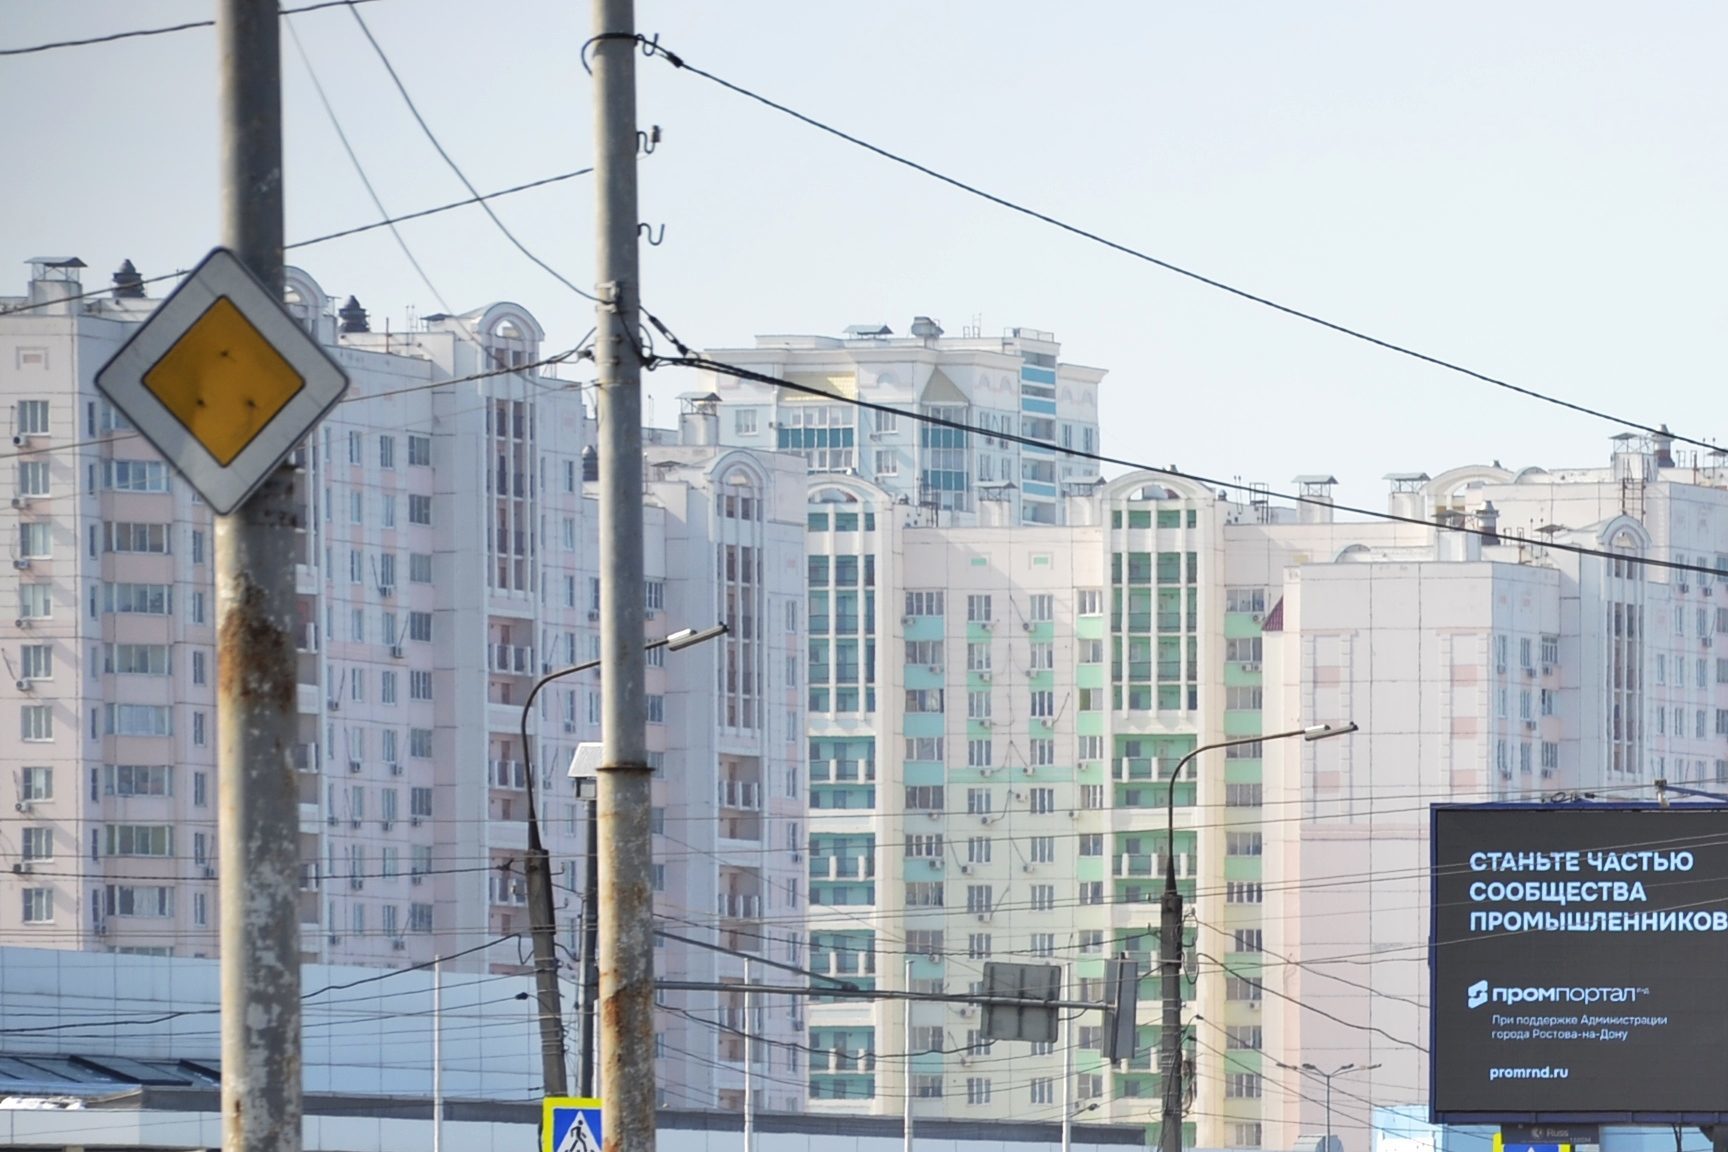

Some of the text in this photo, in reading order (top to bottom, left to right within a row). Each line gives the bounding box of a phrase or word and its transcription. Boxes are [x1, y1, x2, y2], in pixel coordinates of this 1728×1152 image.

[1469, 851, 1694, 872] СТАНЬТЕ ЧАСТЬЮ
[1469, 881, 1647, 906] СООБЩЕСТВА
[1469, 911, 1728, 932] ПРОМЫШЛЕННИКОВ
[1491, 986, 1636, 1005] промпортал
[1491, 1014, 1668, 1027] При поддержке Администрации
[1491, 1028, 1628, 1041] города Ростова-на-Дону
[1489, 1065, 1569, 1080] promrnd.ru
